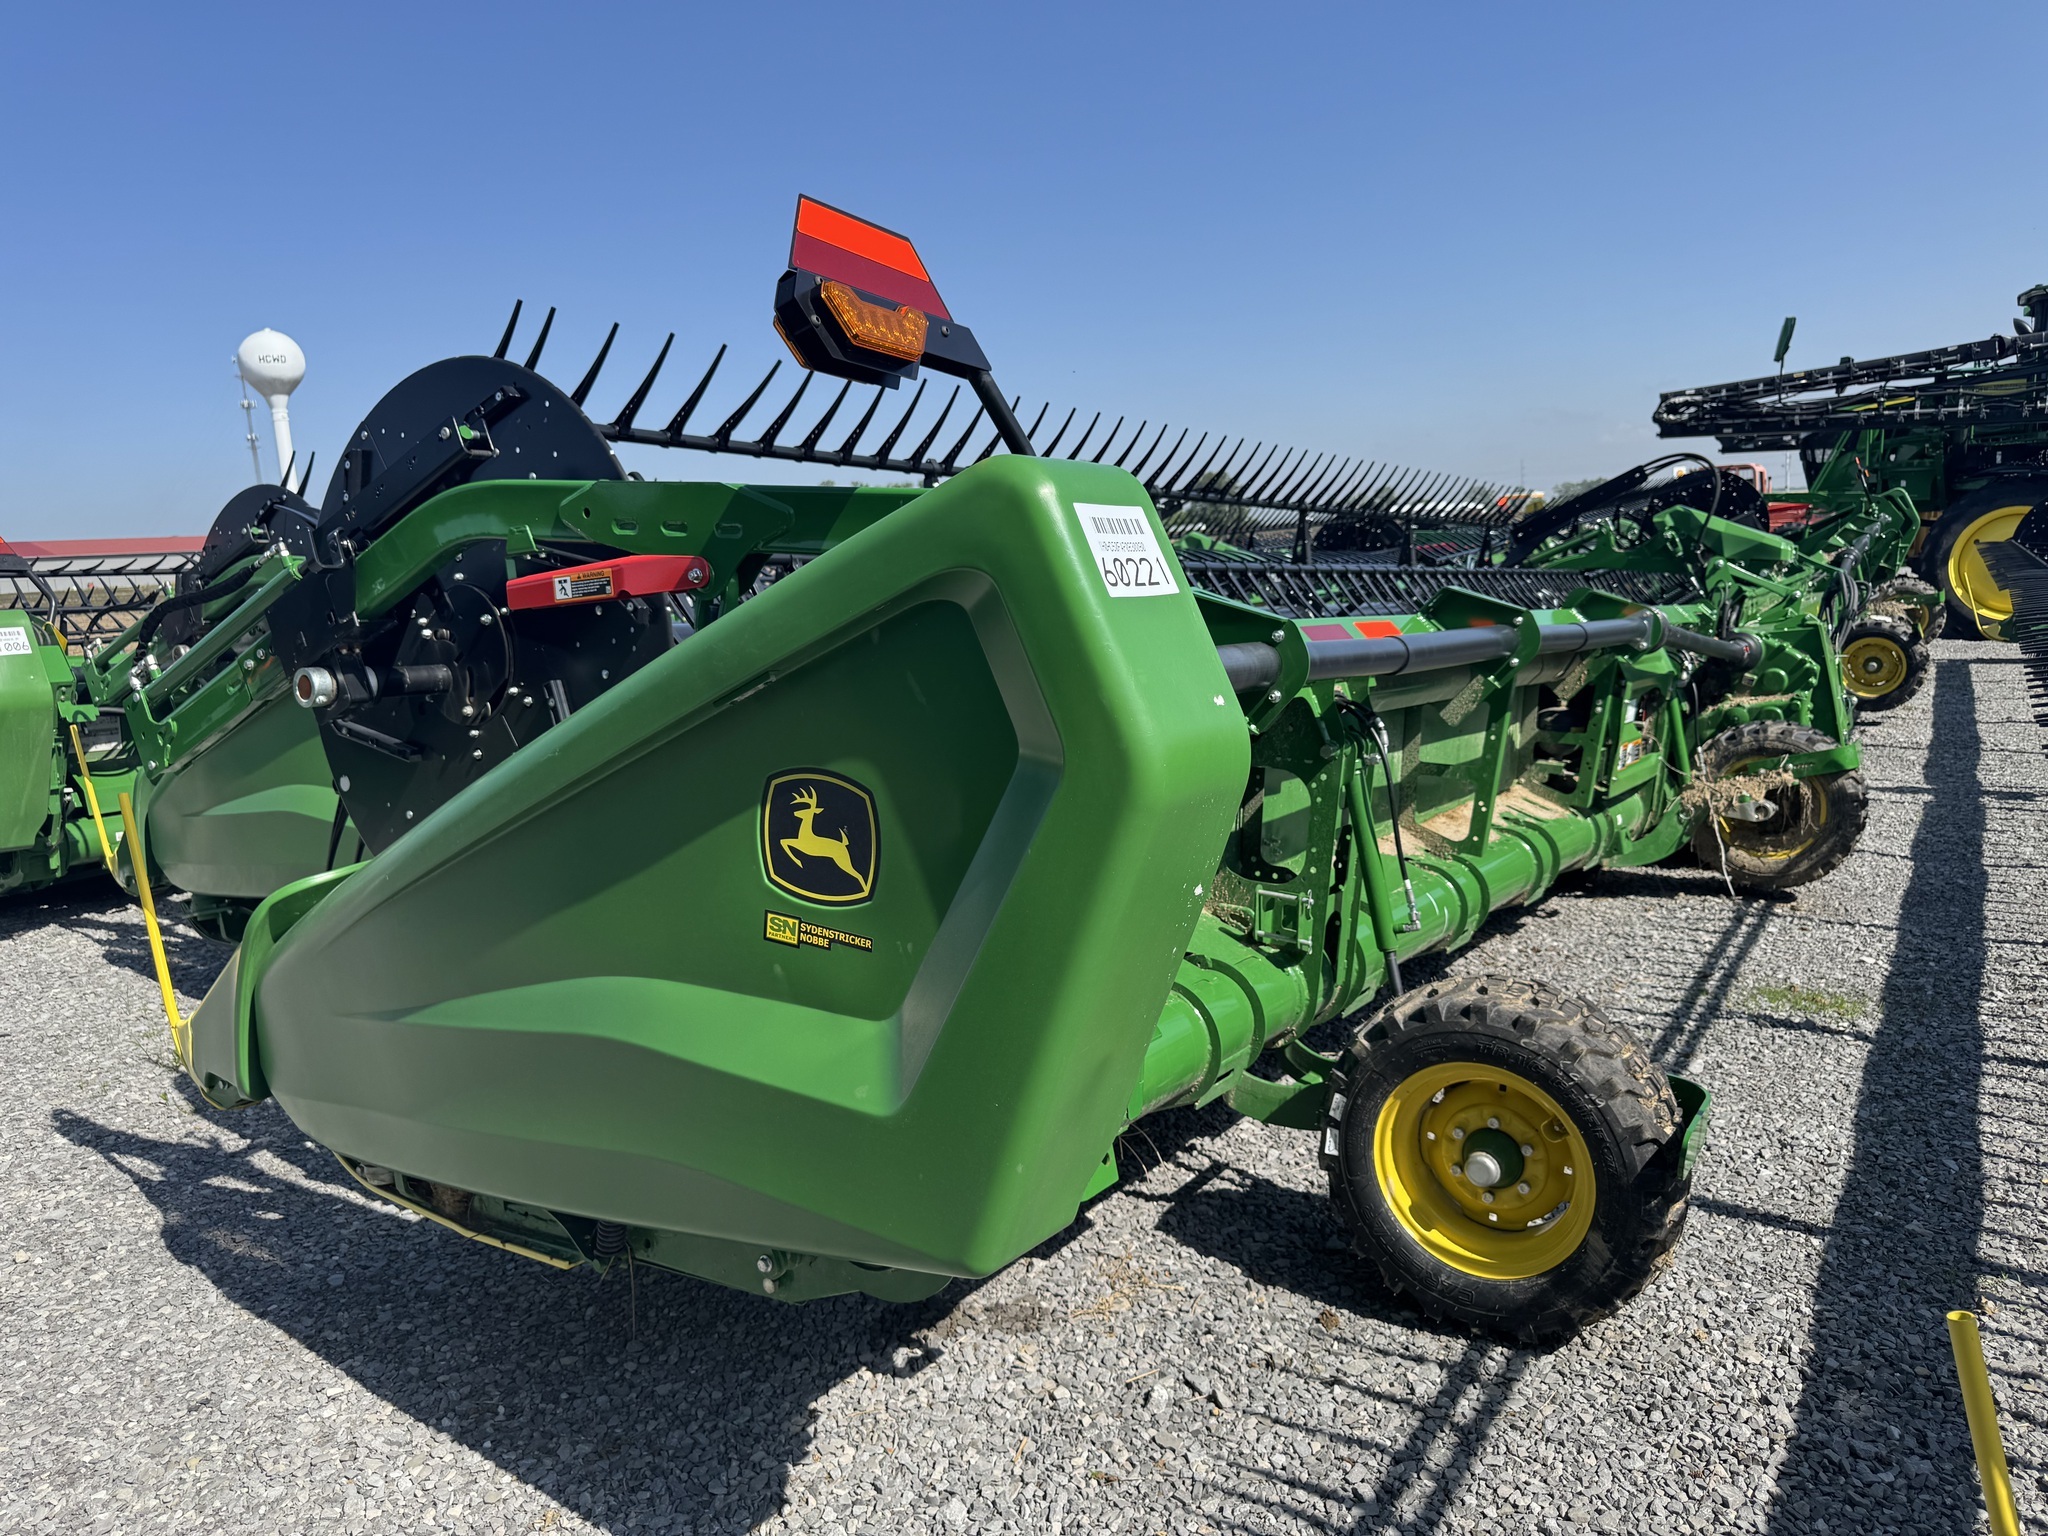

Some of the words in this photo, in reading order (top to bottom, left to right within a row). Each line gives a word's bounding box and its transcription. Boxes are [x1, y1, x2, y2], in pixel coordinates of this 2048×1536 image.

[258, 354, 287, 364] HCWD
[582, 570, 605, 578] WARNING
[1101, 557, 1170, 587] 60221
[0, 641, 30, 652] 006
[769, 916, 797, 936] SN
[800, 922, 872, 949] SYDENSTRICKER
[800, 932, 830, 948] NOBBE
